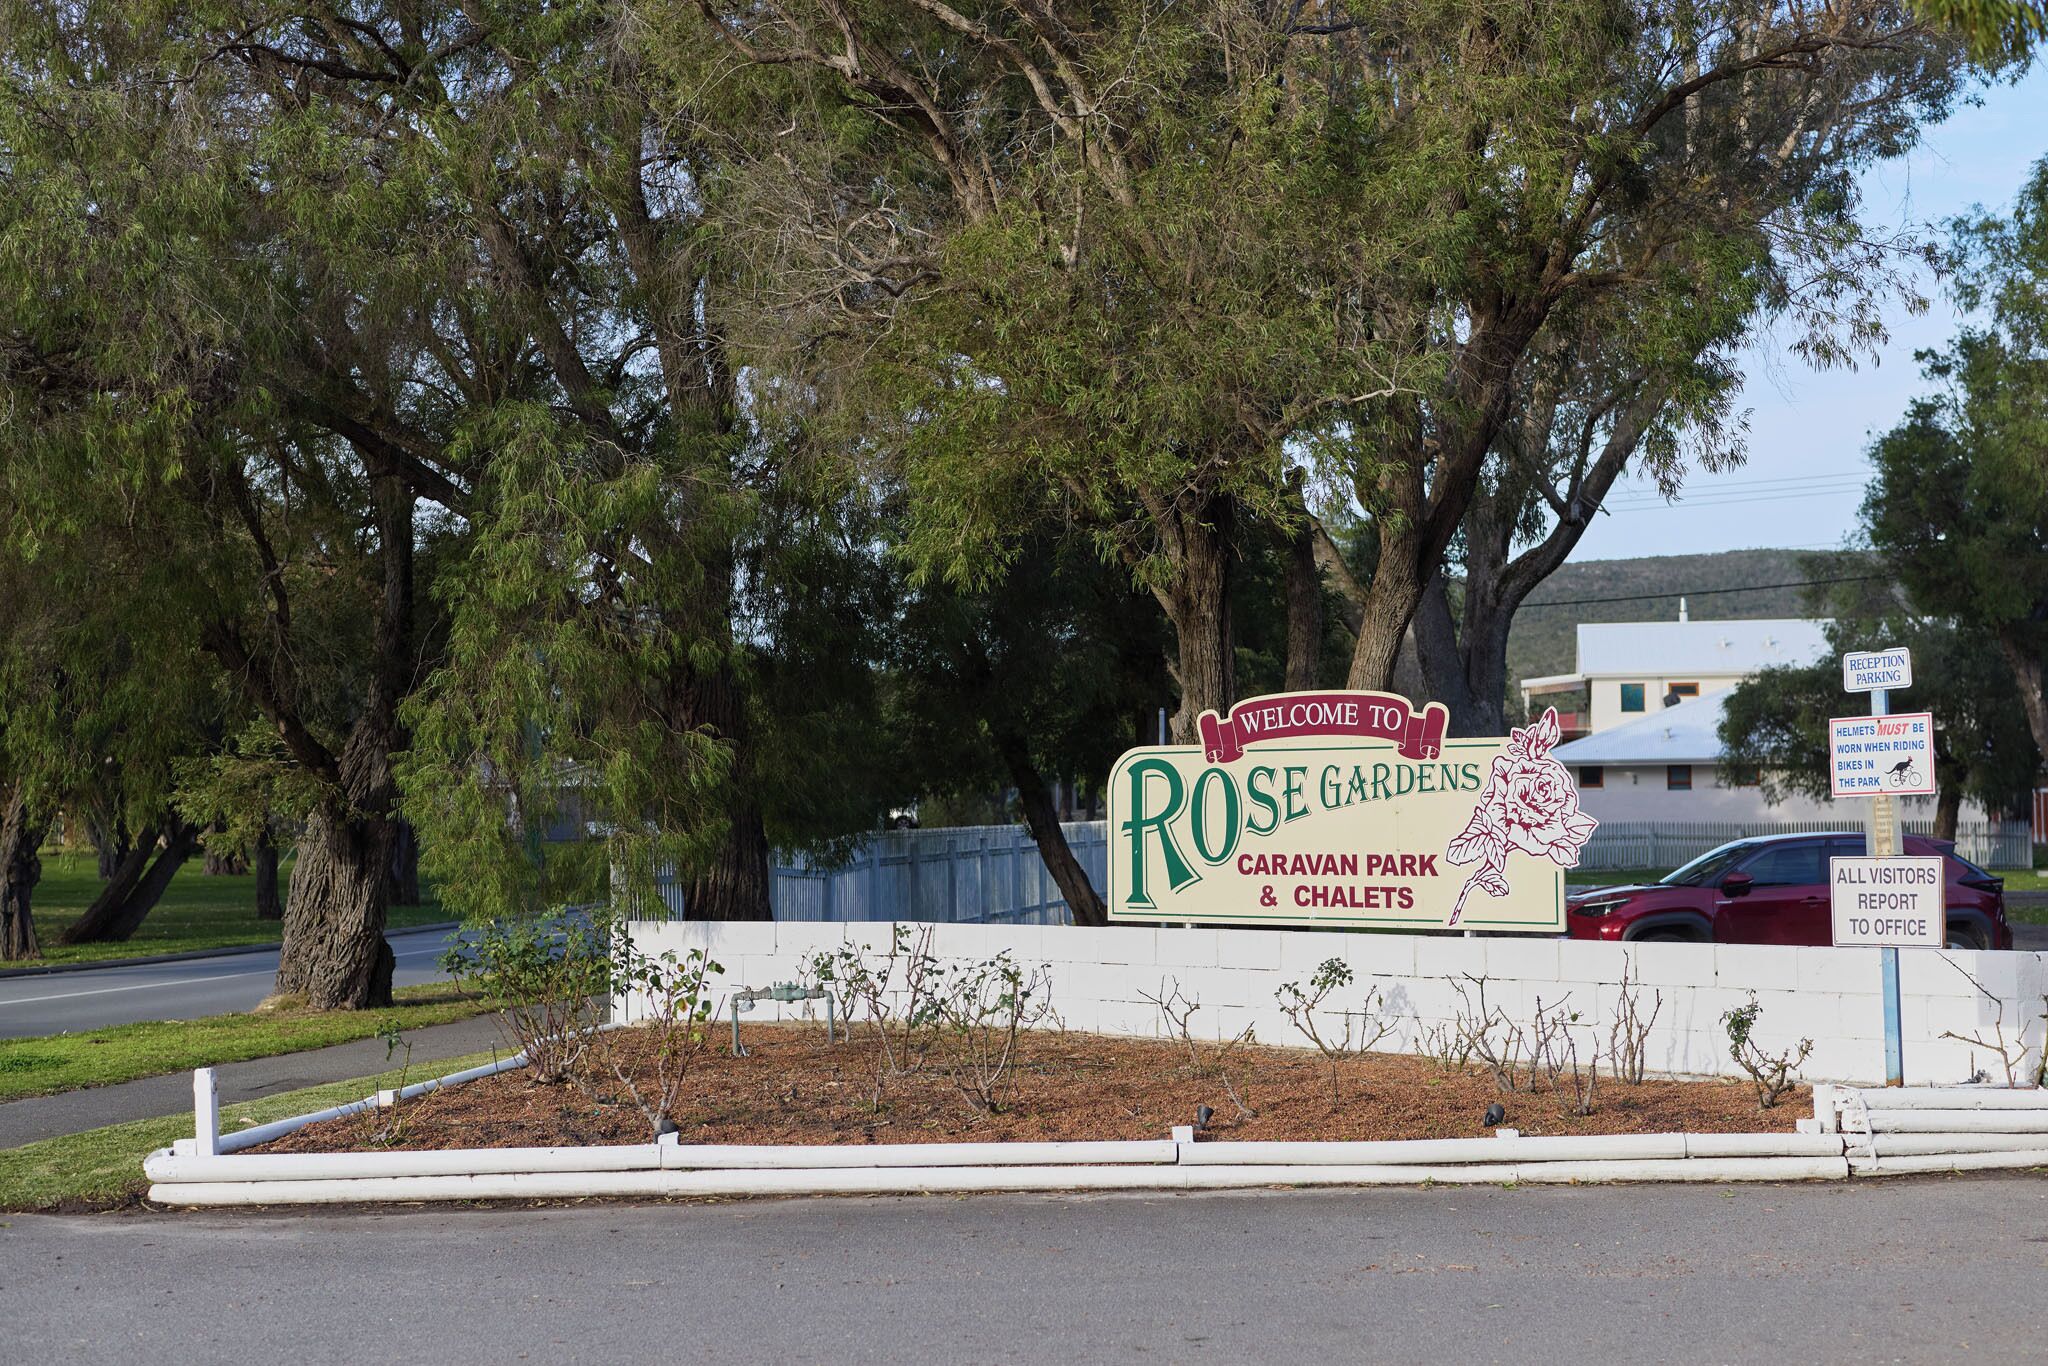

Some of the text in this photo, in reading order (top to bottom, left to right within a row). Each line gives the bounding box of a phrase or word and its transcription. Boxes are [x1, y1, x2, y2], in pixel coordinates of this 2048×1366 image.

[1850, 654, 1905, 671] RECEPTION
[1856, 670, 1901, 685] PARKING
[1239, 702, 1401, 734] WELCOME TO
[1836, 723, 1924, 737] HELMETS MUST BE
[1837, 740, 1925, 754] WORN WHEN RIDING
[1838, 760, 1874, 771] BIKES IN
[1839, 776, 1880, 787] THE PARK
[1122, 758, 1482, 909] ROSE GARDENS
[1237, 853, 1439, 877] CARAVAN PARK
[1837, 867, 1936, 884] ALL VISITORS
[1260, 885, 1414, 909] & CHALETS
[1858, 893, 1918, 909] REPORT
[1850, 919, 1926, 935] TO OFFICE
